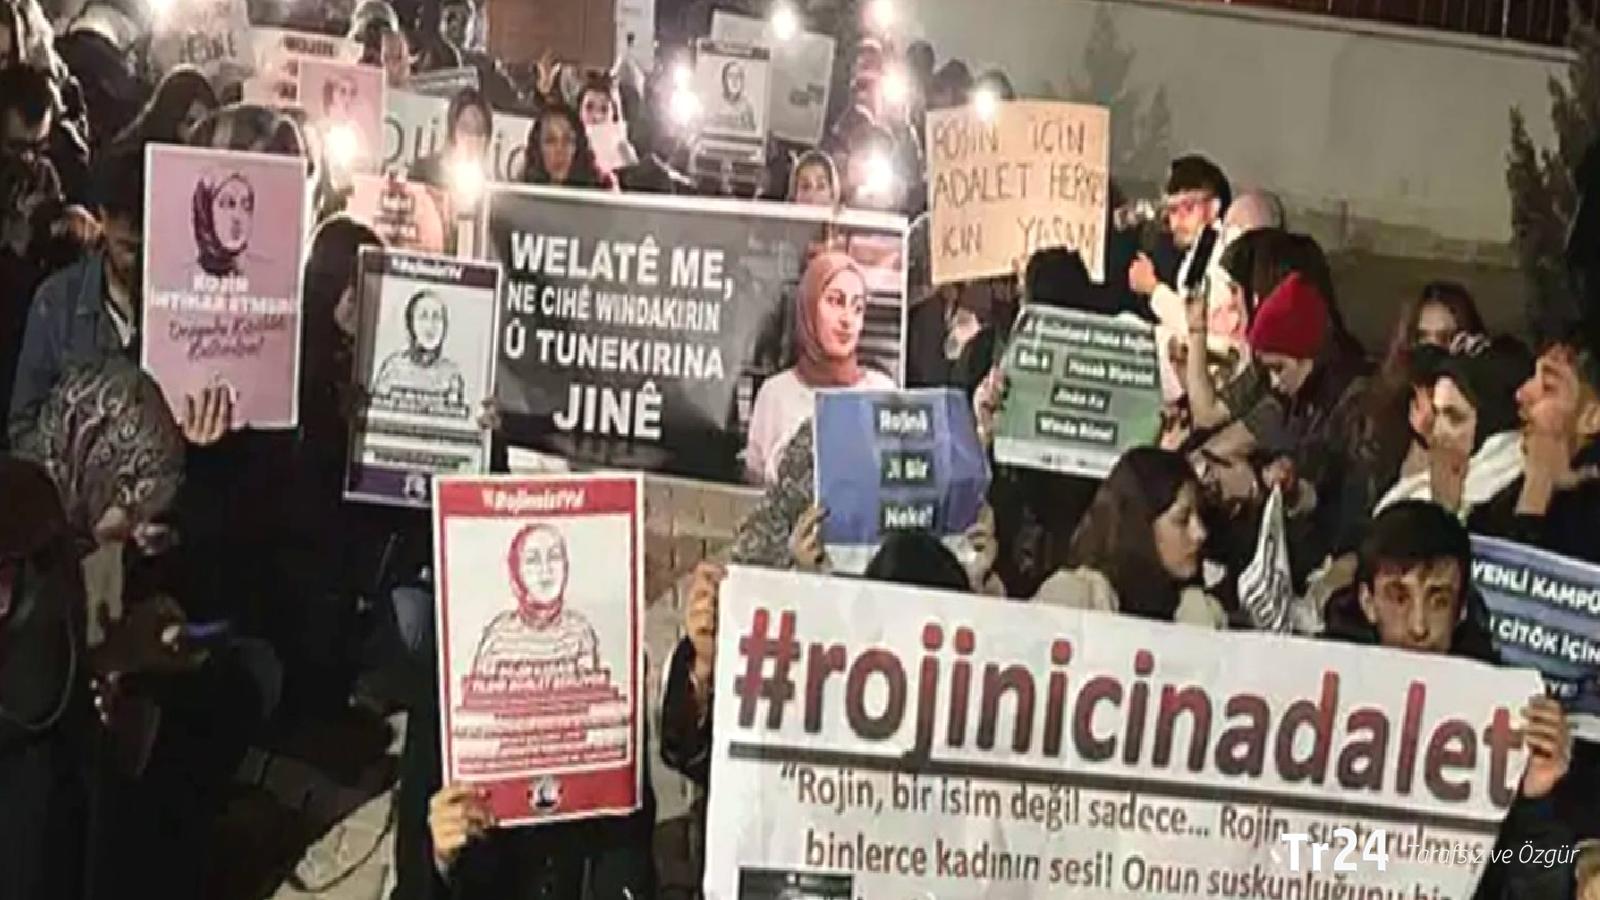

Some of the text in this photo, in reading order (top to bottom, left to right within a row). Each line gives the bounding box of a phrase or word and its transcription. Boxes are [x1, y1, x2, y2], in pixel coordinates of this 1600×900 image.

[510, 231, 660, 285] WELATÊ
[670, 247, 734, 302] ME,
[507, 281, 535, 314] NE
[596, 290, 721, 333] WINDAKIRIN
[536, 329, 724, 379] TUNEKIRINA
[552, 378, 663, 440] JINÊ
[734, 607, 1524, 812] #rojinicinadalet
[892, 768, 932, 812] bir
[941, 775, 1001, 818] isim
[1010, 783, 1080, 833] değil
[1088, 792, 1209, 838] sadece...
[805, 828, 927, 876] binlerce
[935, 837, 1041, 883] kadının
[1122, 855, 1200, 895] Onun
